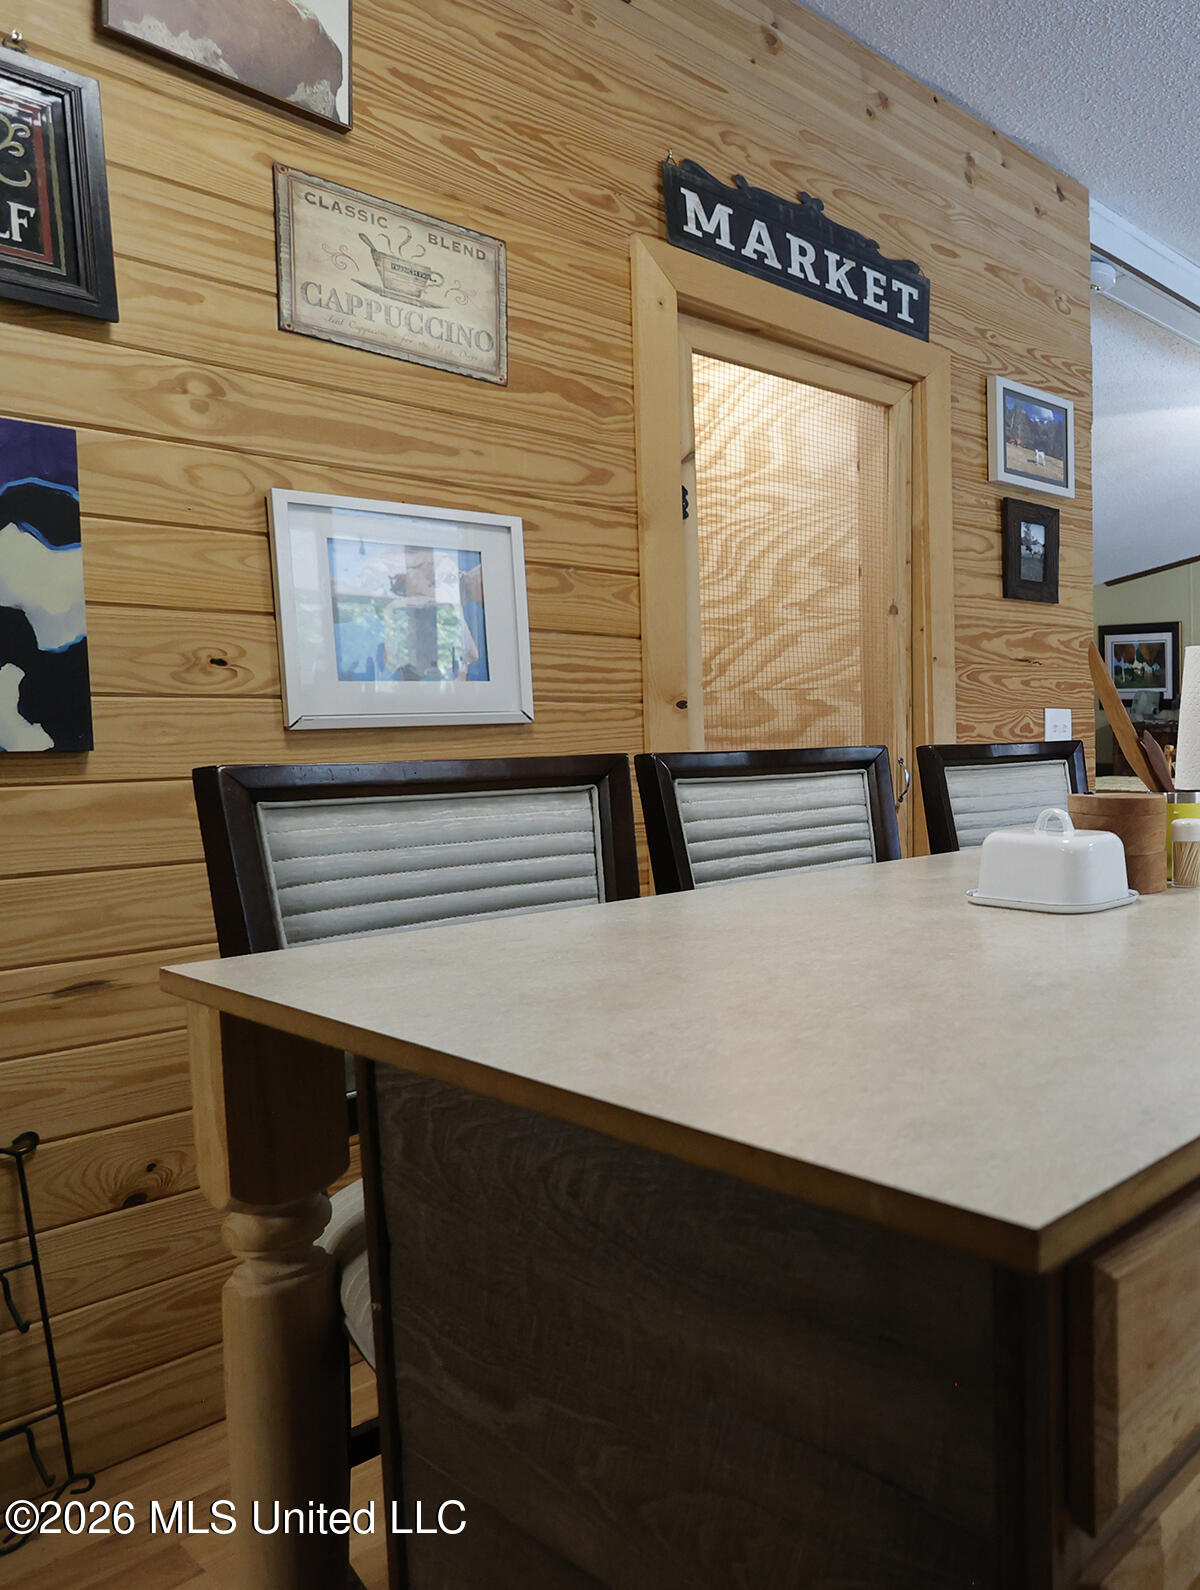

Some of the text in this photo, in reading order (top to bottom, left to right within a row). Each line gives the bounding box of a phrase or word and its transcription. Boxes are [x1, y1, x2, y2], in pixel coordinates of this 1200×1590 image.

[304, 191, 486, 261] CLASSIC BLEND
[680, 187, 918, 324] MARKET
[301, 281, 495, 353] CAPPUCCINO
